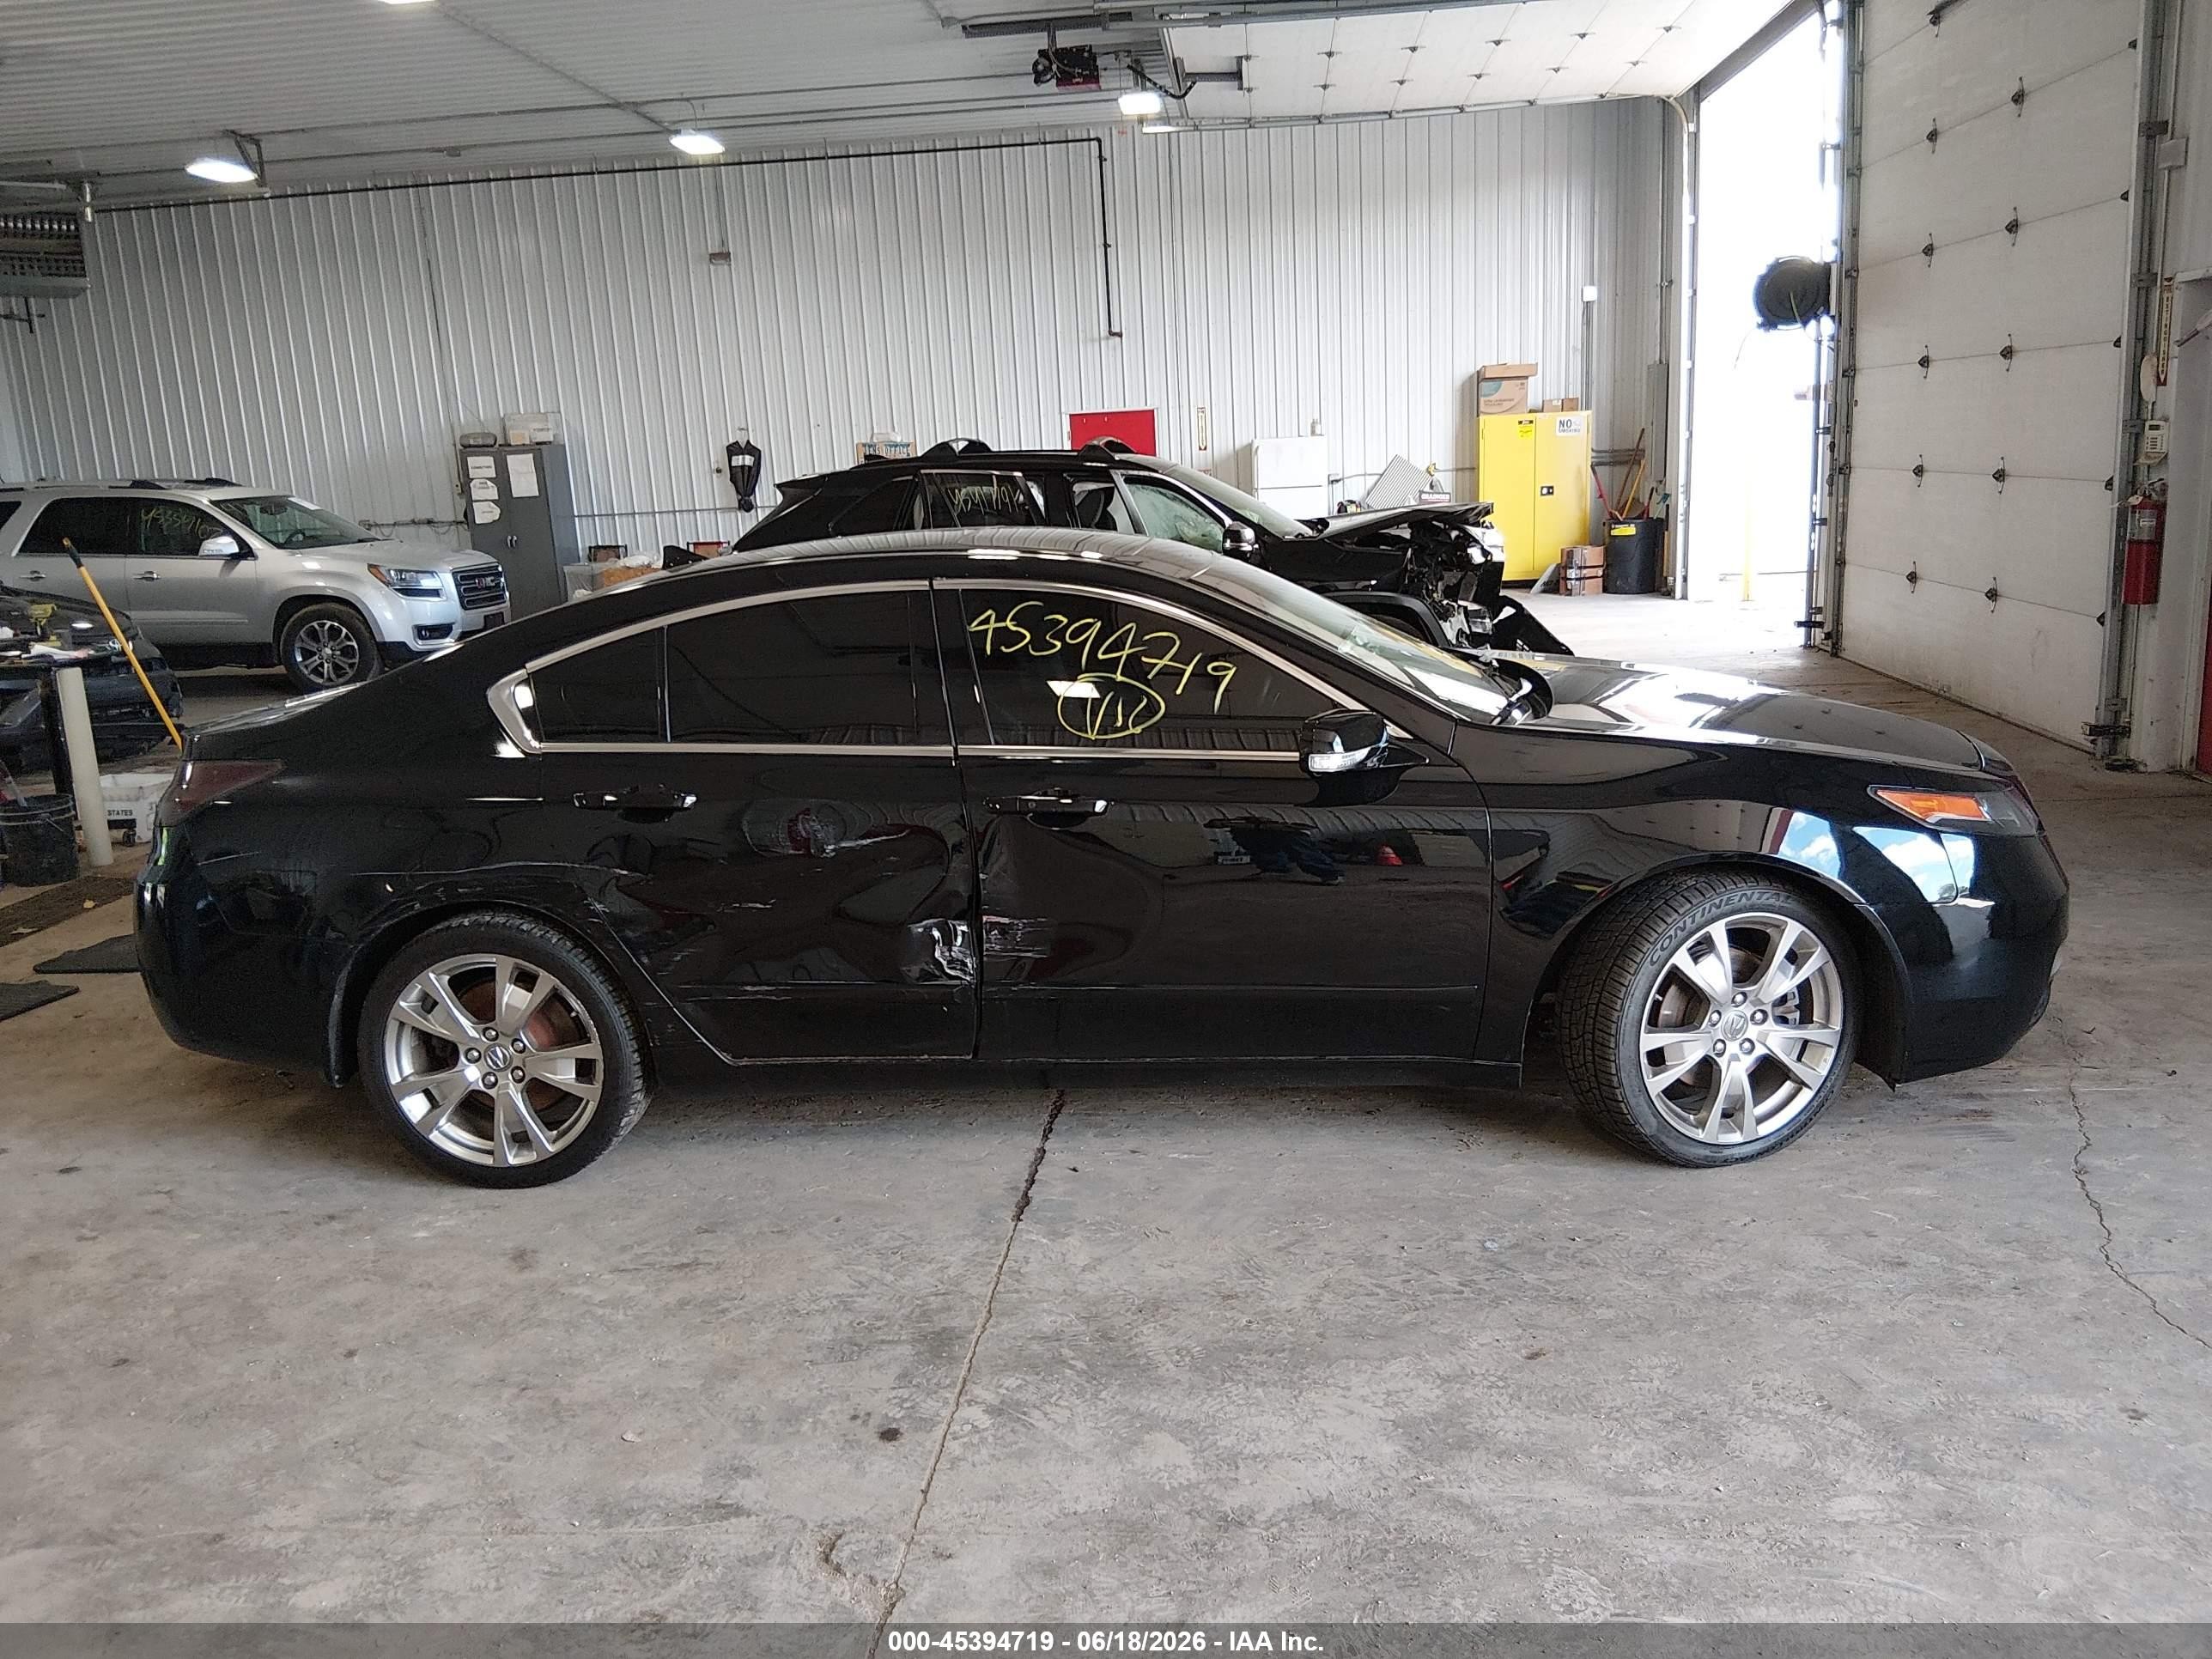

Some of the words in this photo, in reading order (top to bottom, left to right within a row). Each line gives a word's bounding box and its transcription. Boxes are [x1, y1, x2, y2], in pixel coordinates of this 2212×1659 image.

[1559, 418, 1572, 428] NO
[968, 601, 1237, 714] 45394719
[1649, 890, 1797, 967] CONTINENTAL
